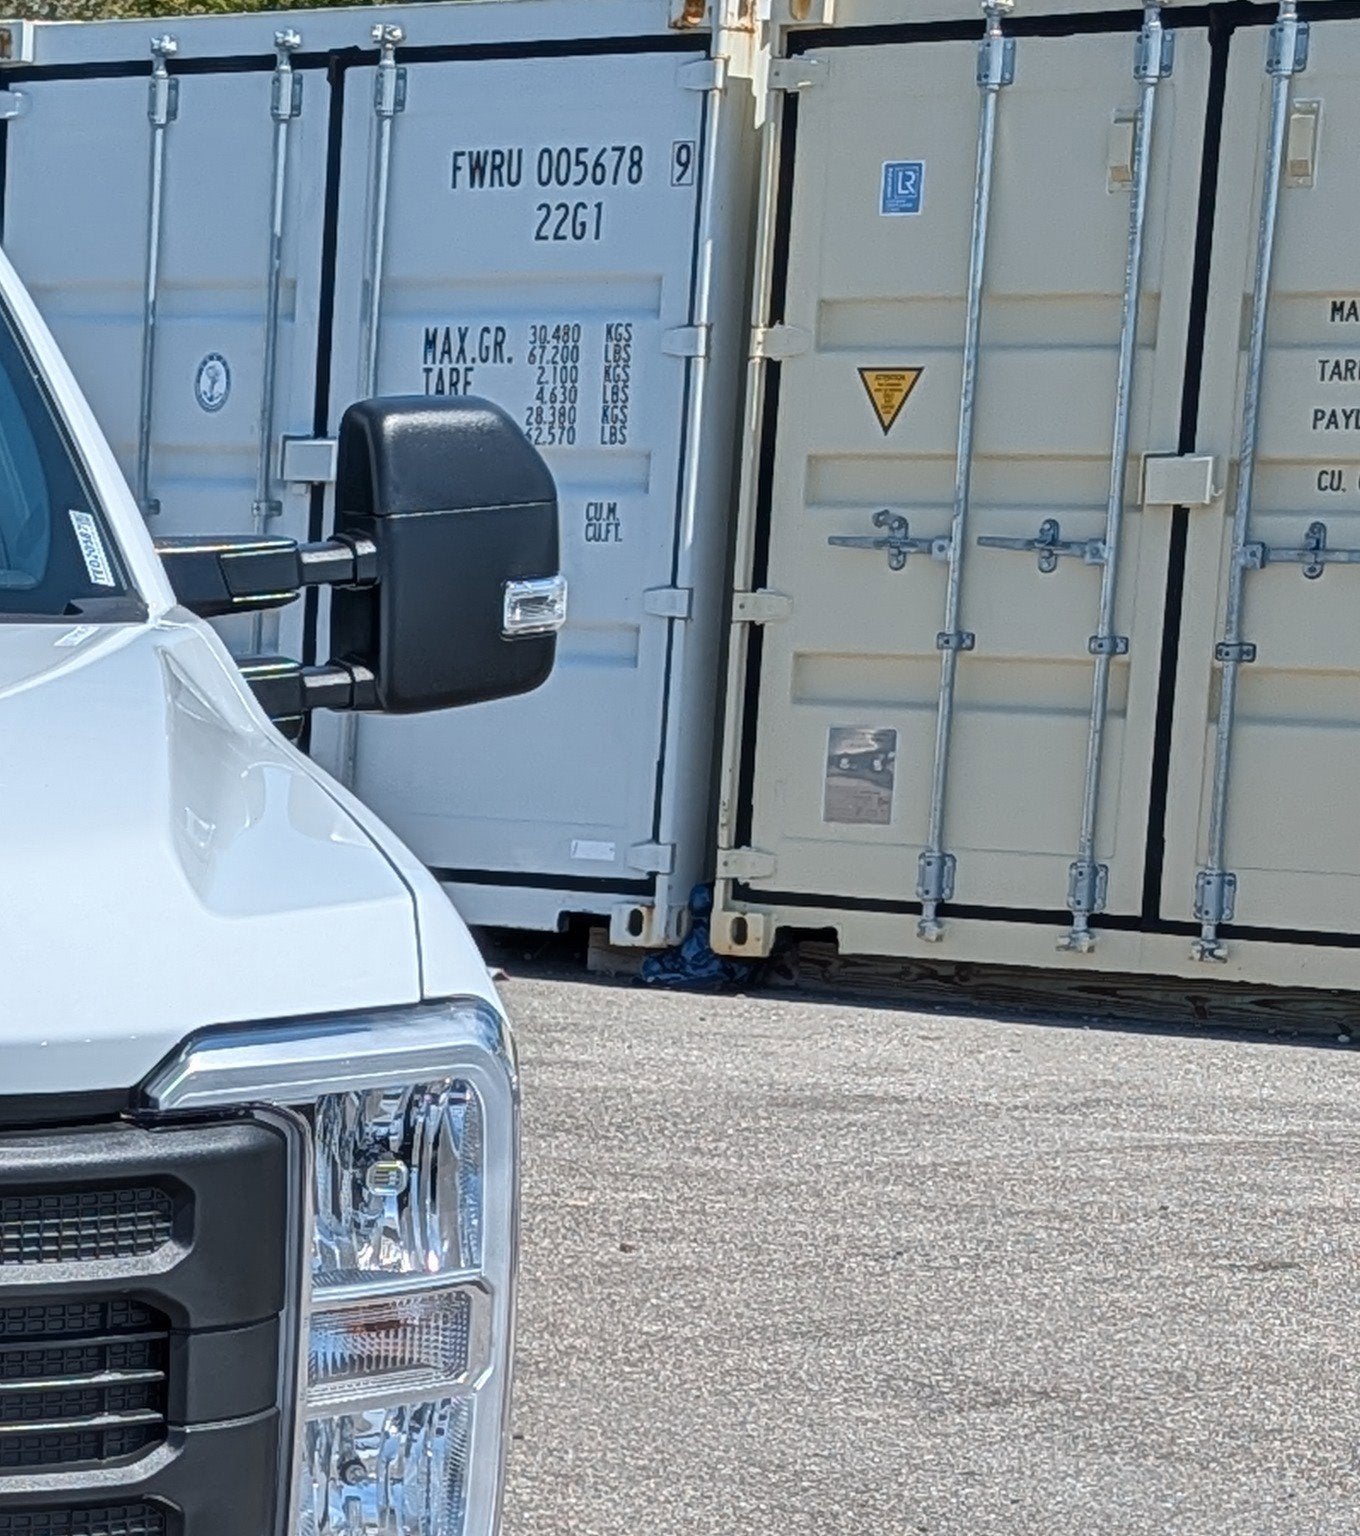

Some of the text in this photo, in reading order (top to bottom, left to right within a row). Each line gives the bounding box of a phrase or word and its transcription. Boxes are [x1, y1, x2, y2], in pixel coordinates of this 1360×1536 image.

[451, 143, 691, 189] FWRU 005678 9
[534, 201, 603, 241] 22G1
[529, 323, 580, 344] 30.480
[605, 322, 633, 342] KGS
[527, 344, 631, 365] 67.200 LBS
[536, 366, 578, 385] 2.100
[603, 364, 630, 384] KGS
[1318, 359, 1360, 382] TAR
[535, 385, 629, 404] 4.630 LBS
[601, 405, 628, 424] KGS
[600, 425, 627, 445] LBS
[1317, 469, 1347, 492] CU.
